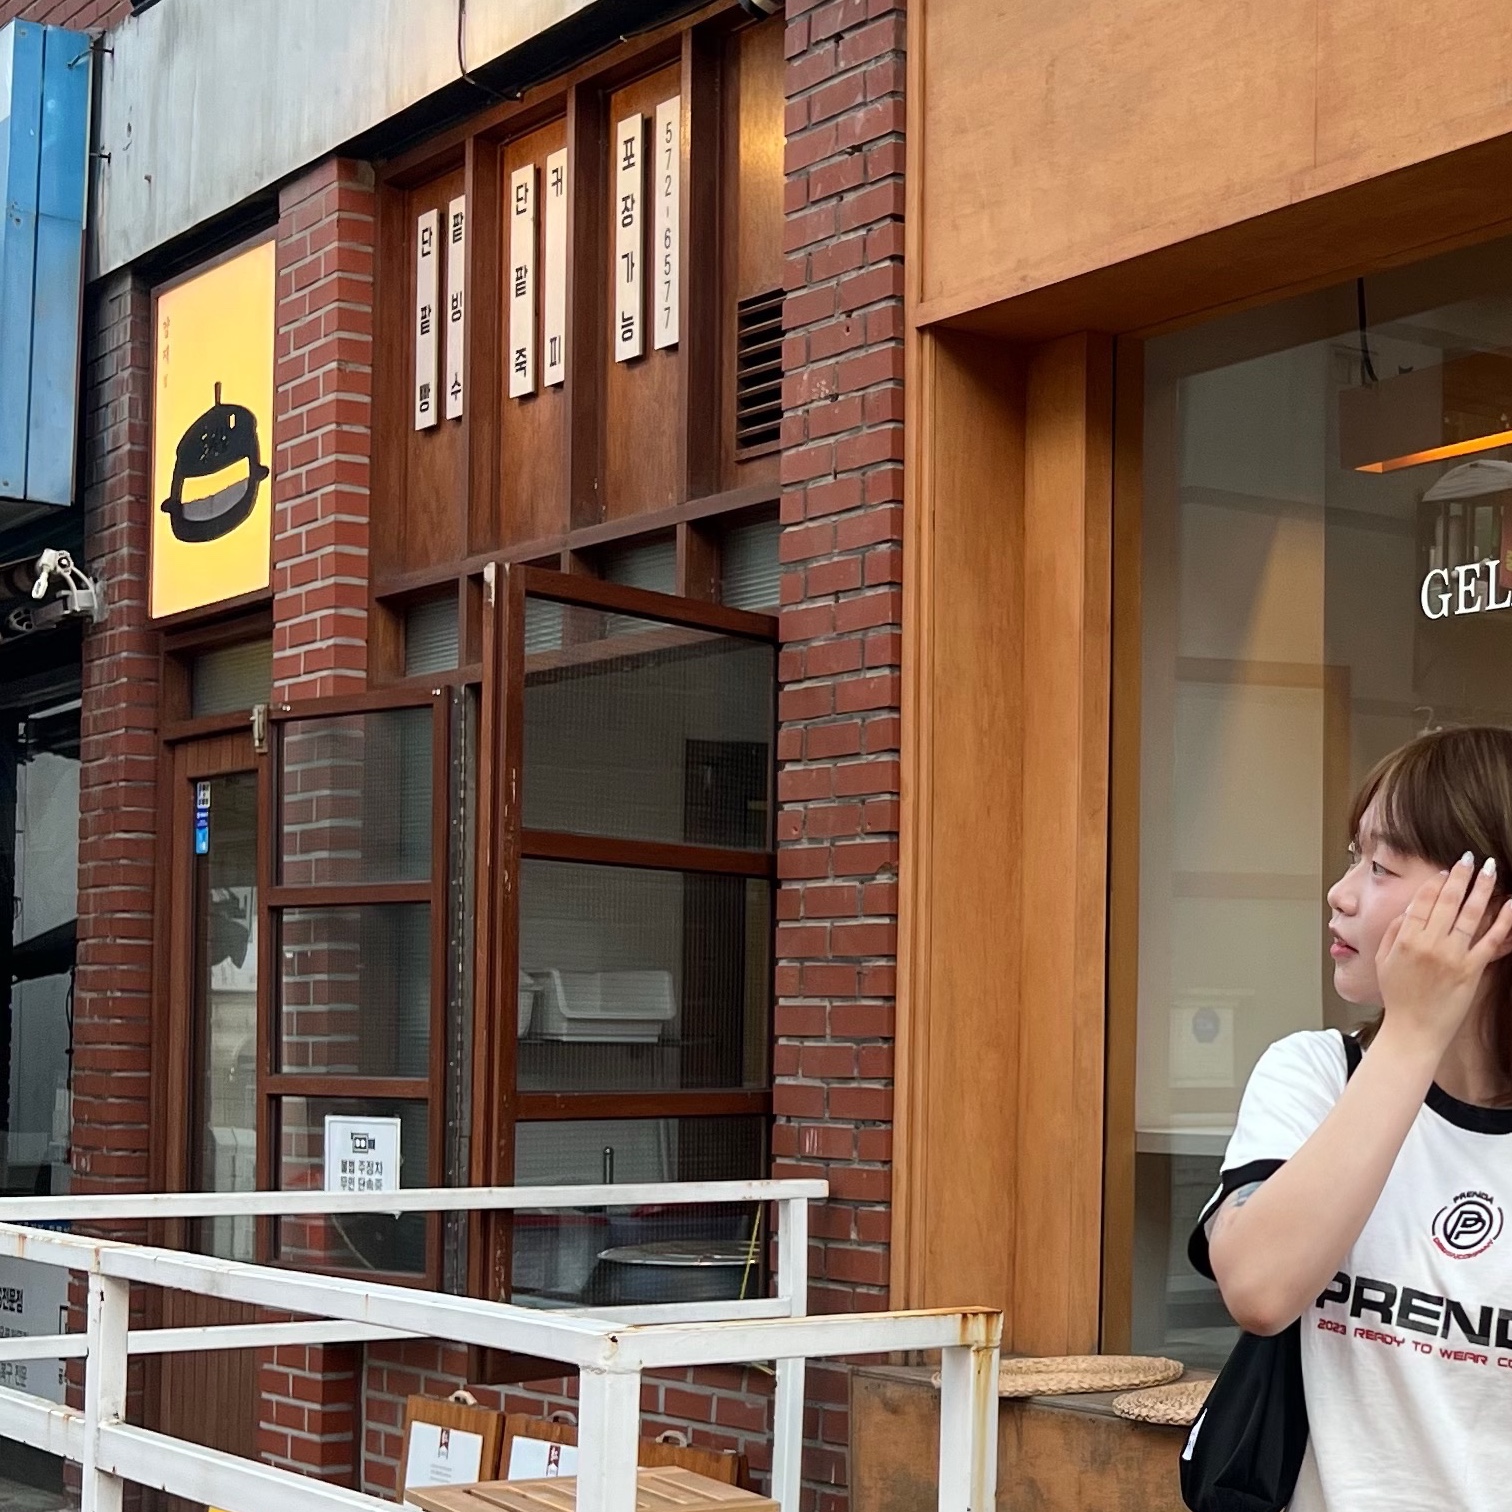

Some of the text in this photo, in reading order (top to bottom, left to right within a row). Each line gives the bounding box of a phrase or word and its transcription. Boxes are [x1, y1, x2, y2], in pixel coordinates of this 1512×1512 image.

[419, 226, 433, 414] 단팥빵
[450, 211, 464, 401] 팥빙수
[514, 182, 529, 378] 단팥죽
[620, 136, 635, 343] 포장가능
[663, 121, 674, 330] 572-6577
[1453, 1190, 1494, 1205] PRENDA
[1317, 1318, 1347, 1336] 2023
[1354, 1327, 1405, 1348] READY
[1412, 1340, 1433, 1355] TO
[1439, 1348, 1488, 1366] WEAR
